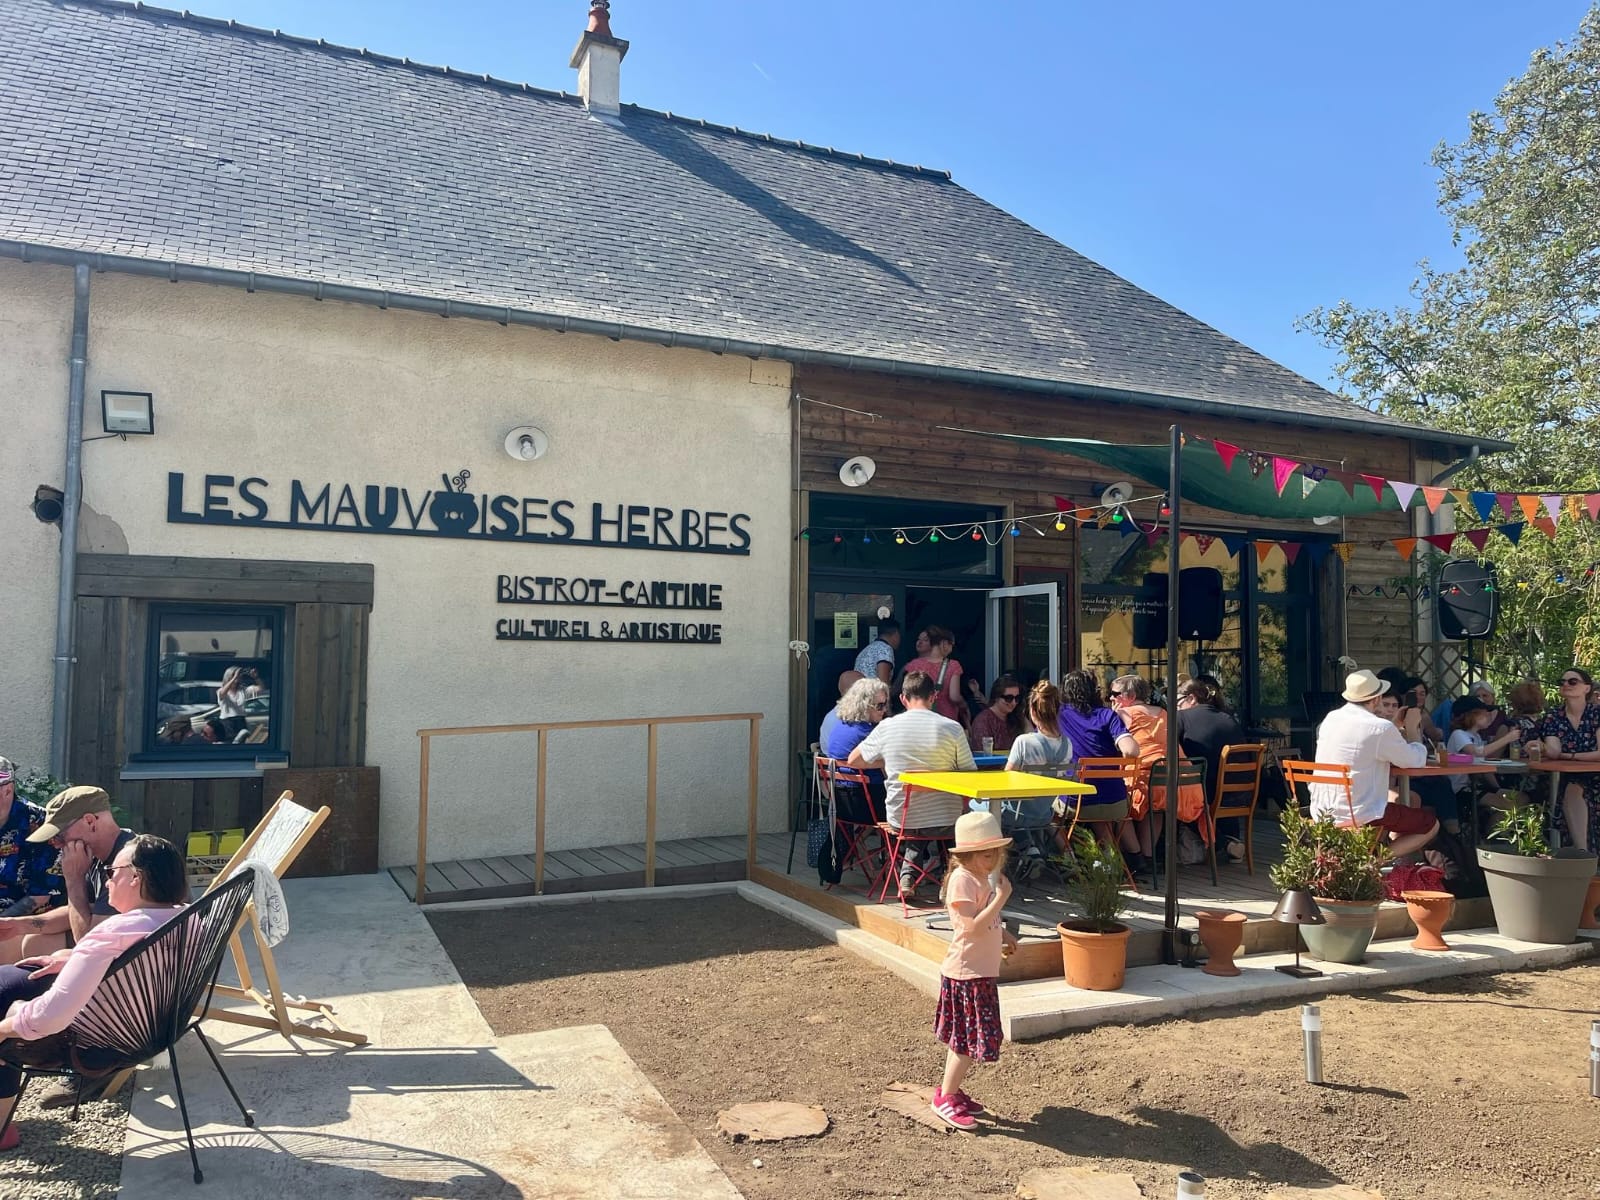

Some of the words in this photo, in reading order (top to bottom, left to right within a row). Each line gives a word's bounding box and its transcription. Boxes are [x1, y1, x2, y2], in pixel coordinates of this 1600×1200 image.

[168, 471, 270, 525] LES
[592, 502, 751, 555] HERBES
[497, 574, 723, 609] BISTROT-CANTINE
[496, 618, 595, 641] CULTUREL
[600, 619, 614, 640] &
[618, 621, 722, 643] ARTISTIQUE
